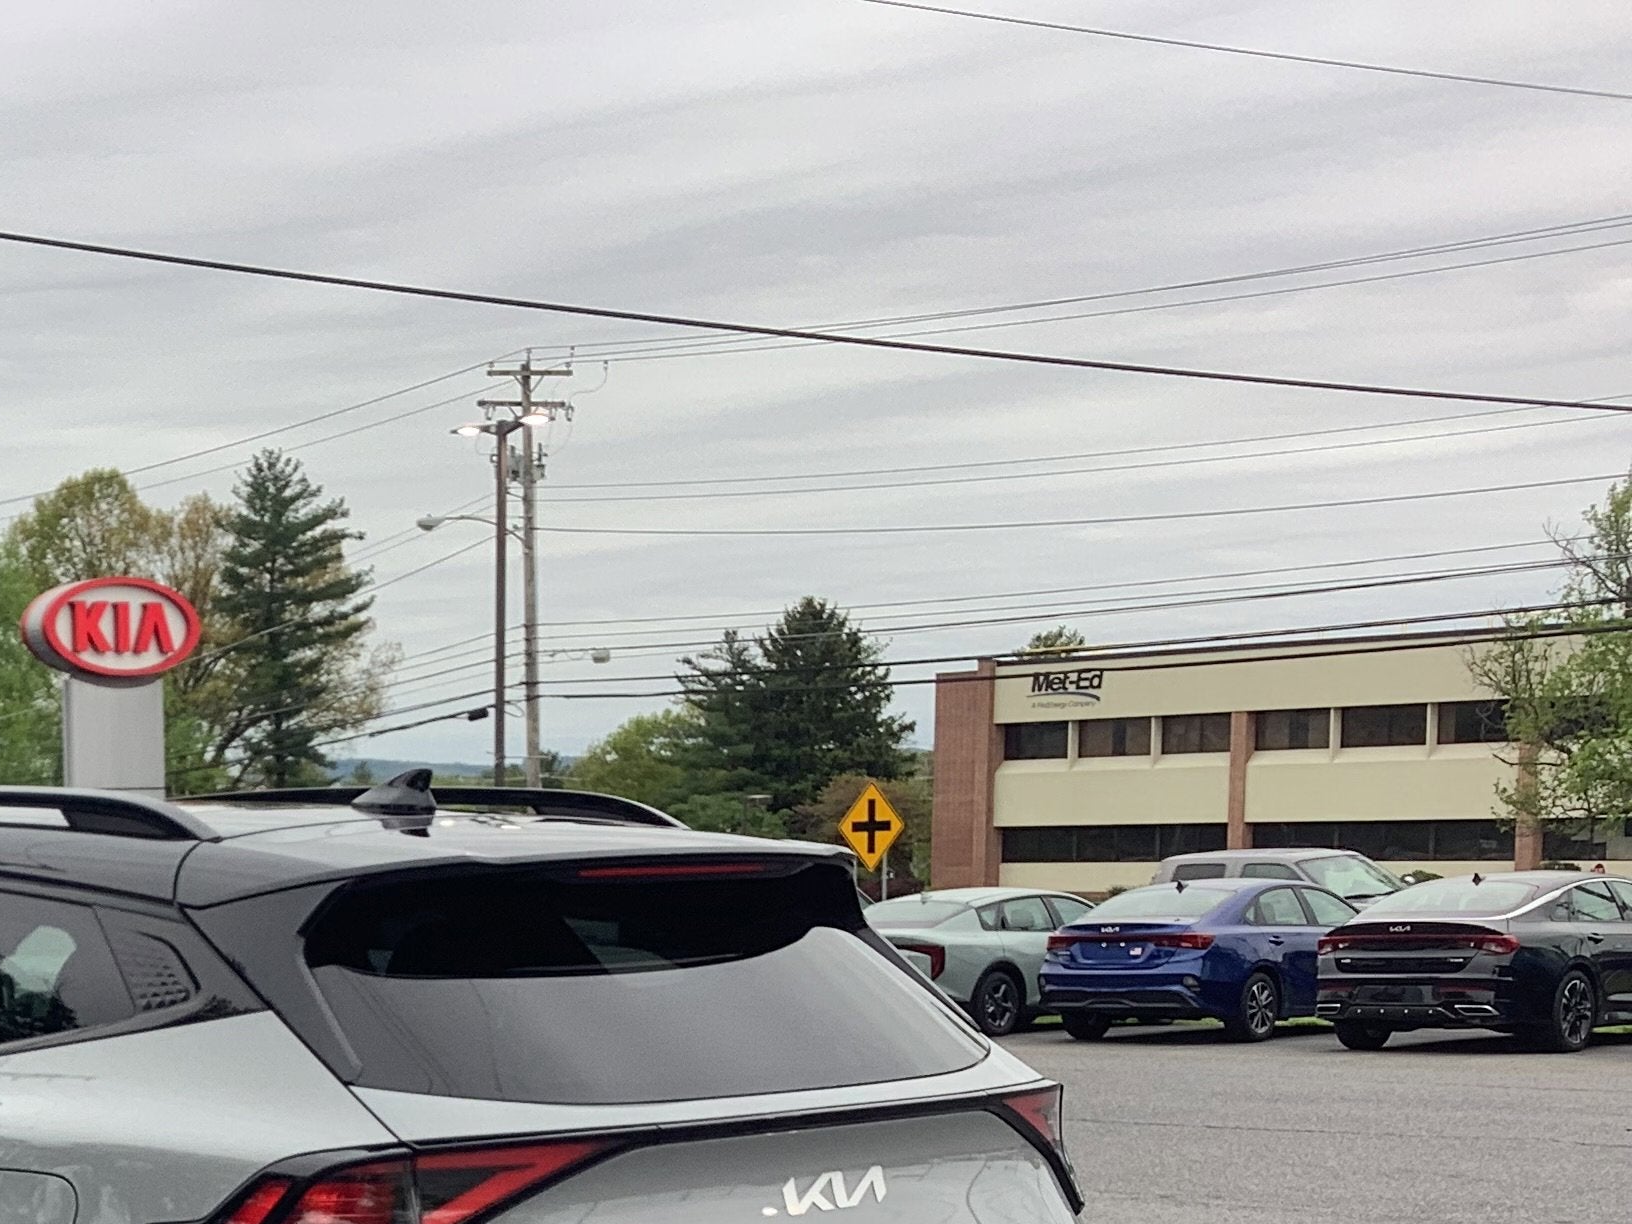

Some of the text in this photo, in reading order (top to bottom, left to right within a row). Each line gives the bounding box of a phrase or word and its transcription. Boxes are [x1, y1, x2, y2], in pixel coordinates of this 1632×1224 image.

[68, 601, 176, 655] KIA
[1031, 669, 1104, 693] Met-Ed
[782, 1165, 887, 1216] KIA
